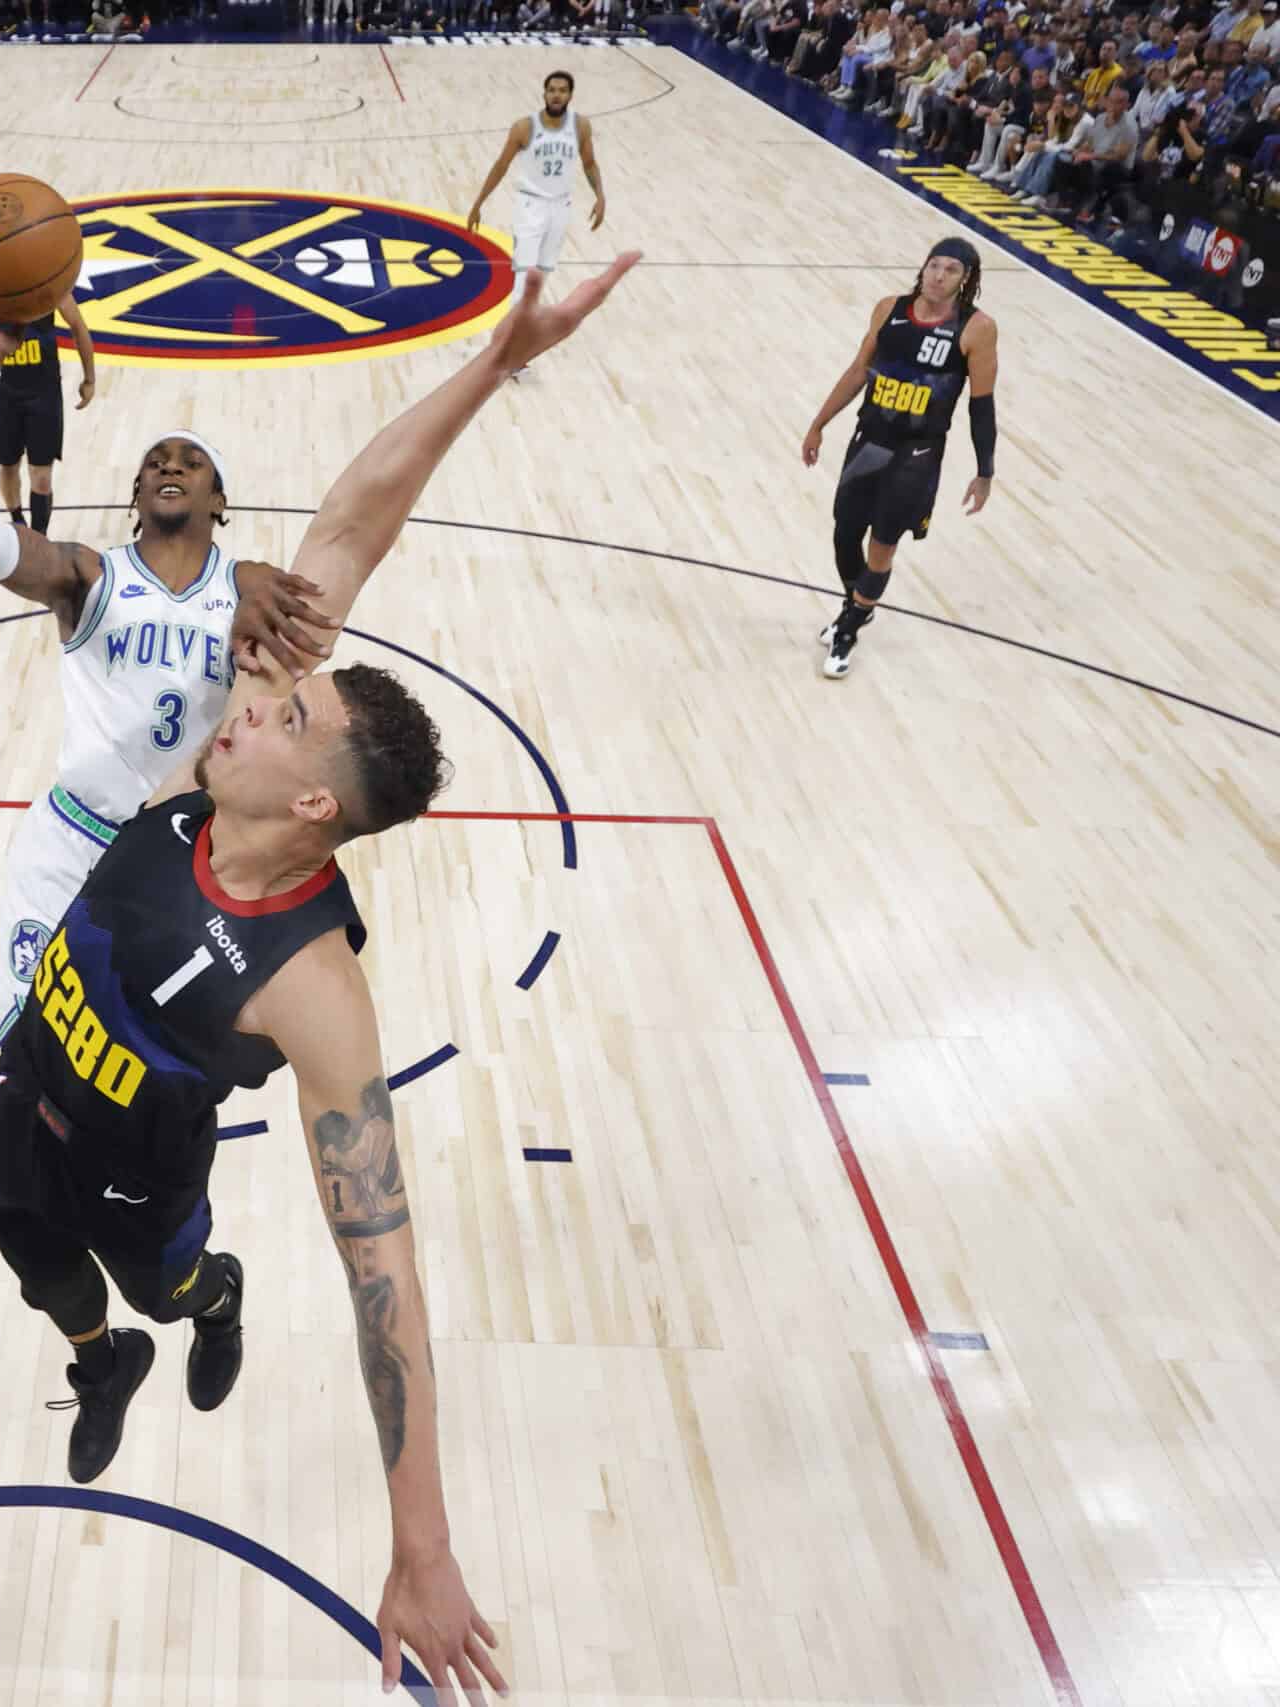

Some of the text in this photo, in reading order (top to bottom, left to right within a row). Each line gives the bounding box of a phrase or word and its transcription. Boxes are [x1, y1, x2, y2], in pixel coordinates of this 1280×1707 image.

[542, 160, 564, 177] 32
[916, 335, 952, 367] 50
[872, 373, 932, 416] 5280
[104, 619, 237, 689] WOLVE
[150, 689, 188, 751] 3
[150, 944, 215, 1007] 1
[205, 915, 248, 975] ibotta
[34, 927, 147, 1108] 5280
